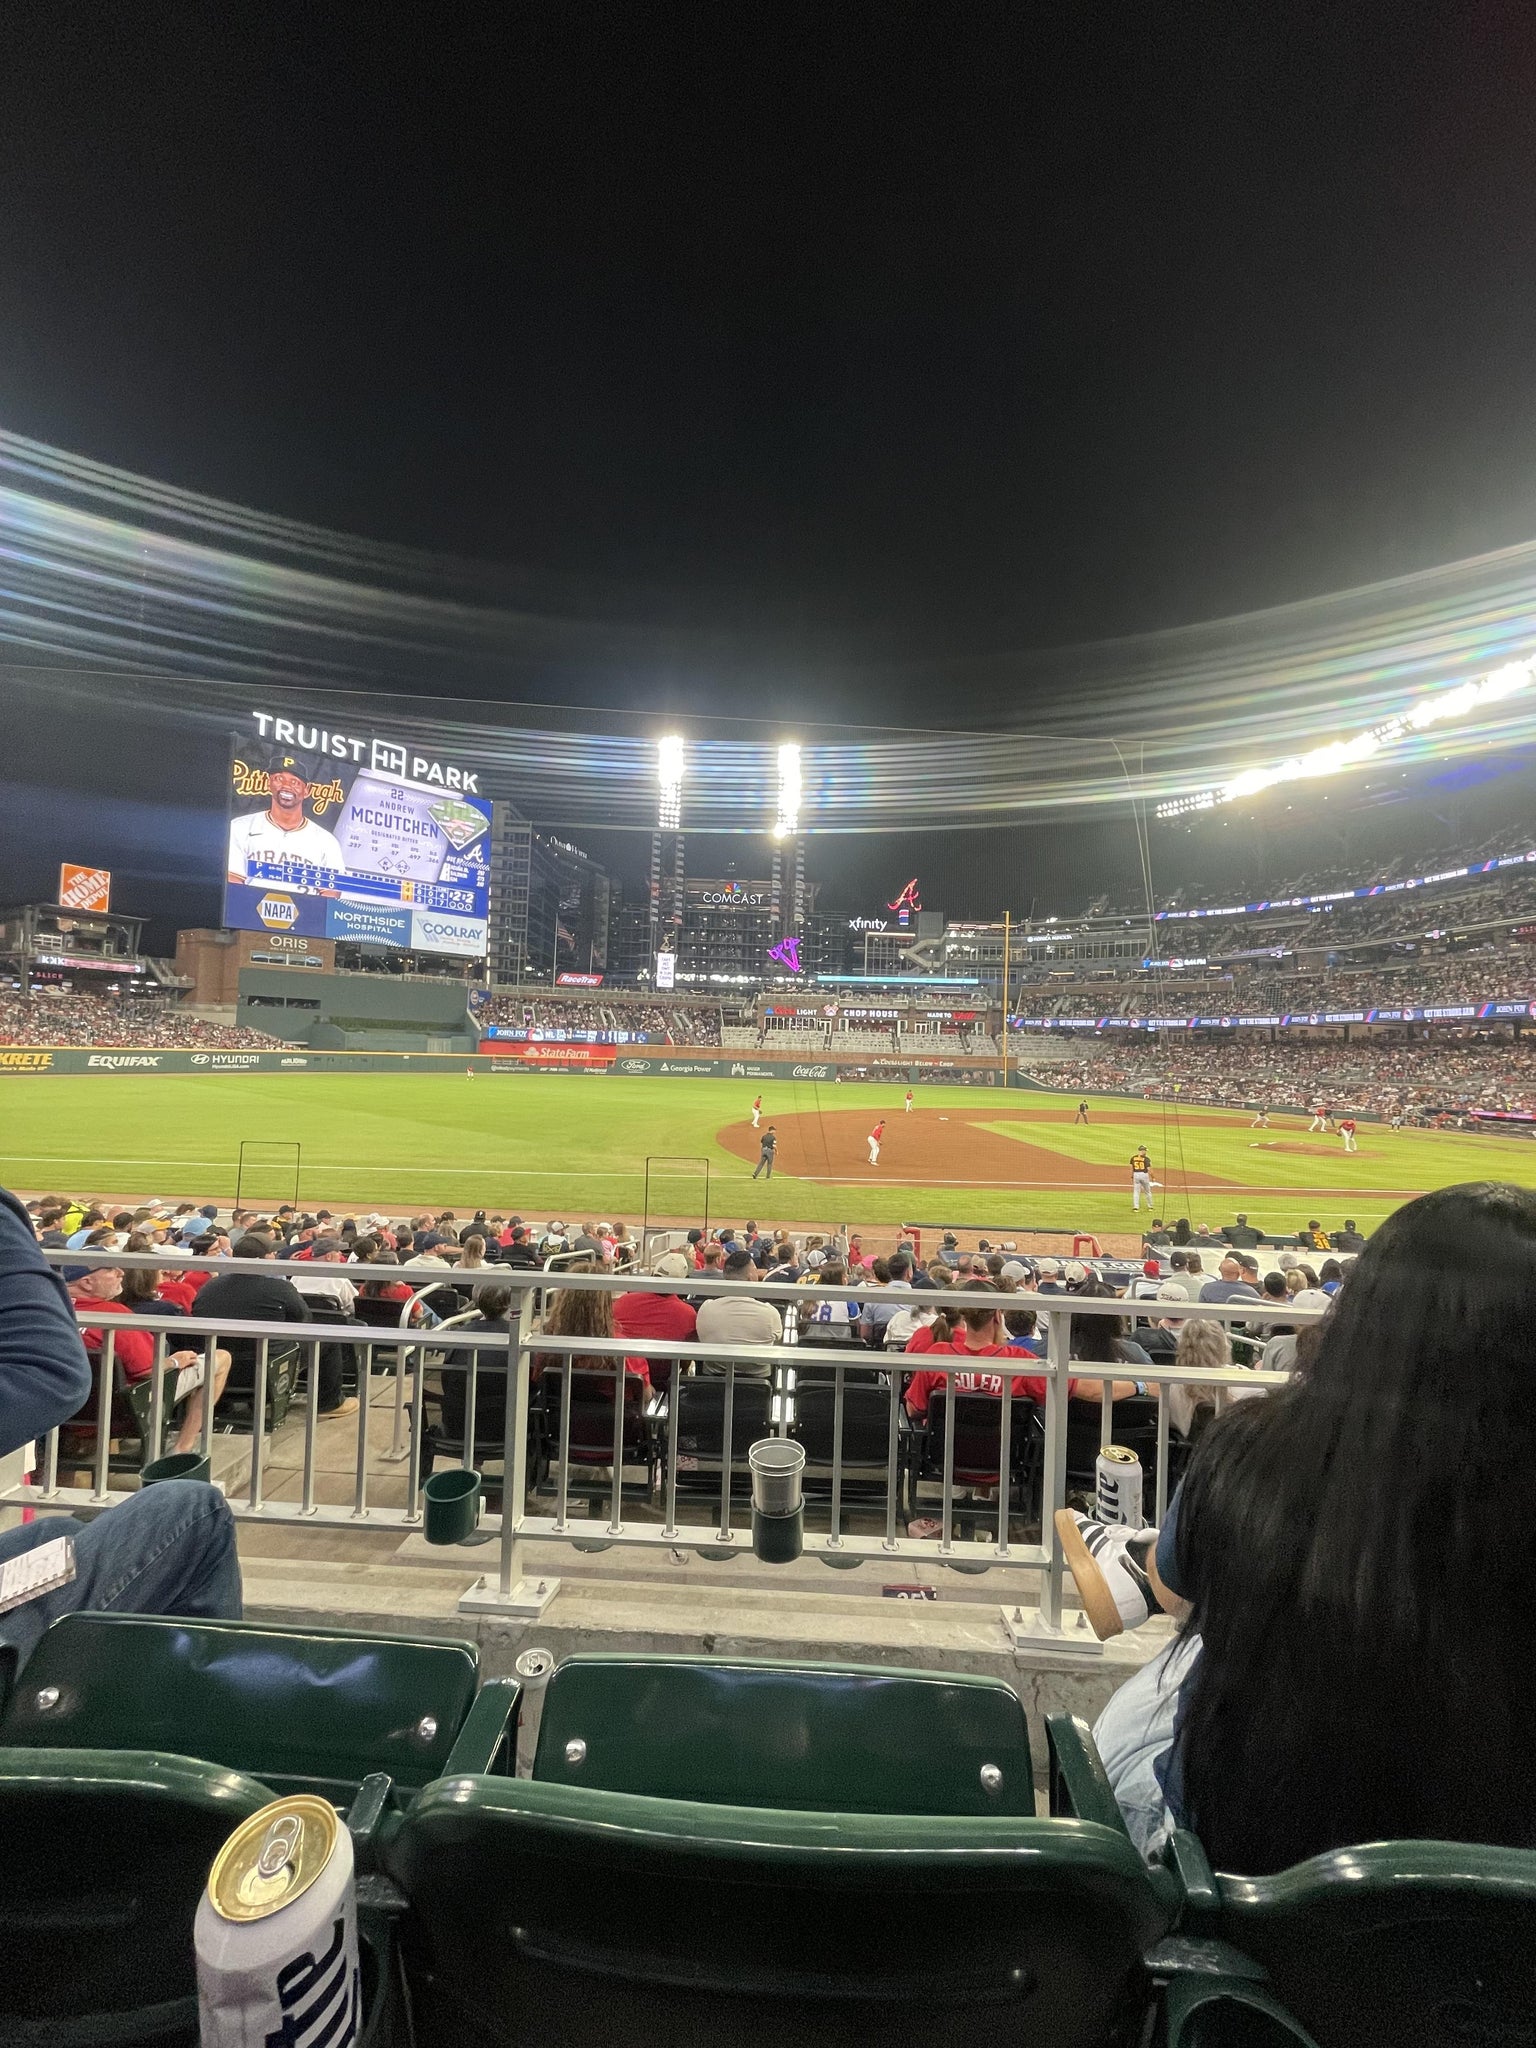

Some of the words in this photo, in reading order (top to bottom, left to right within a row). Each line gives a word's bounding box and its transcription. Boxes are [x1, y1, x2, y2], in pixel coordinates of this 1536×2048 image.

[253, 711, 366, 762] TRUIST
[413, 757, 479, 794] PARK
[391, 788, 404, 800] 22
[380, 800, 415, 815] ANDREW
[351, 806, 438, 839] MCCUTCHEN
[68, 872, 88, 887] THE
[62, 871, 110, 907] HOME
[80, 888, 109, 910] DEPOT
[703, 892, 762, 905] COMCAST
[264, 902, 292, 920] NAPA
[334, 911, 406, 928] NORTHSIDE
[848, 916, 888, 932] xfinity
[347, 922, 392, 934] HOSPITAL
[424, 922, 483, 940] COOLRAY
[270, 936, 308, 950] ORIS
[561, 976, 598, 985] RaceTrac
[870, 1010, 898, 1018] HOUSE
[88, 1056, 159, 1069] EQUIFAX
[212, 1056, 260, 1064] HYUNDAI
[626, 1060, 645, 1070] Ford
[670, 1065, 693, 1074] Georgia
[694, 1066, 712, 1074] Power
